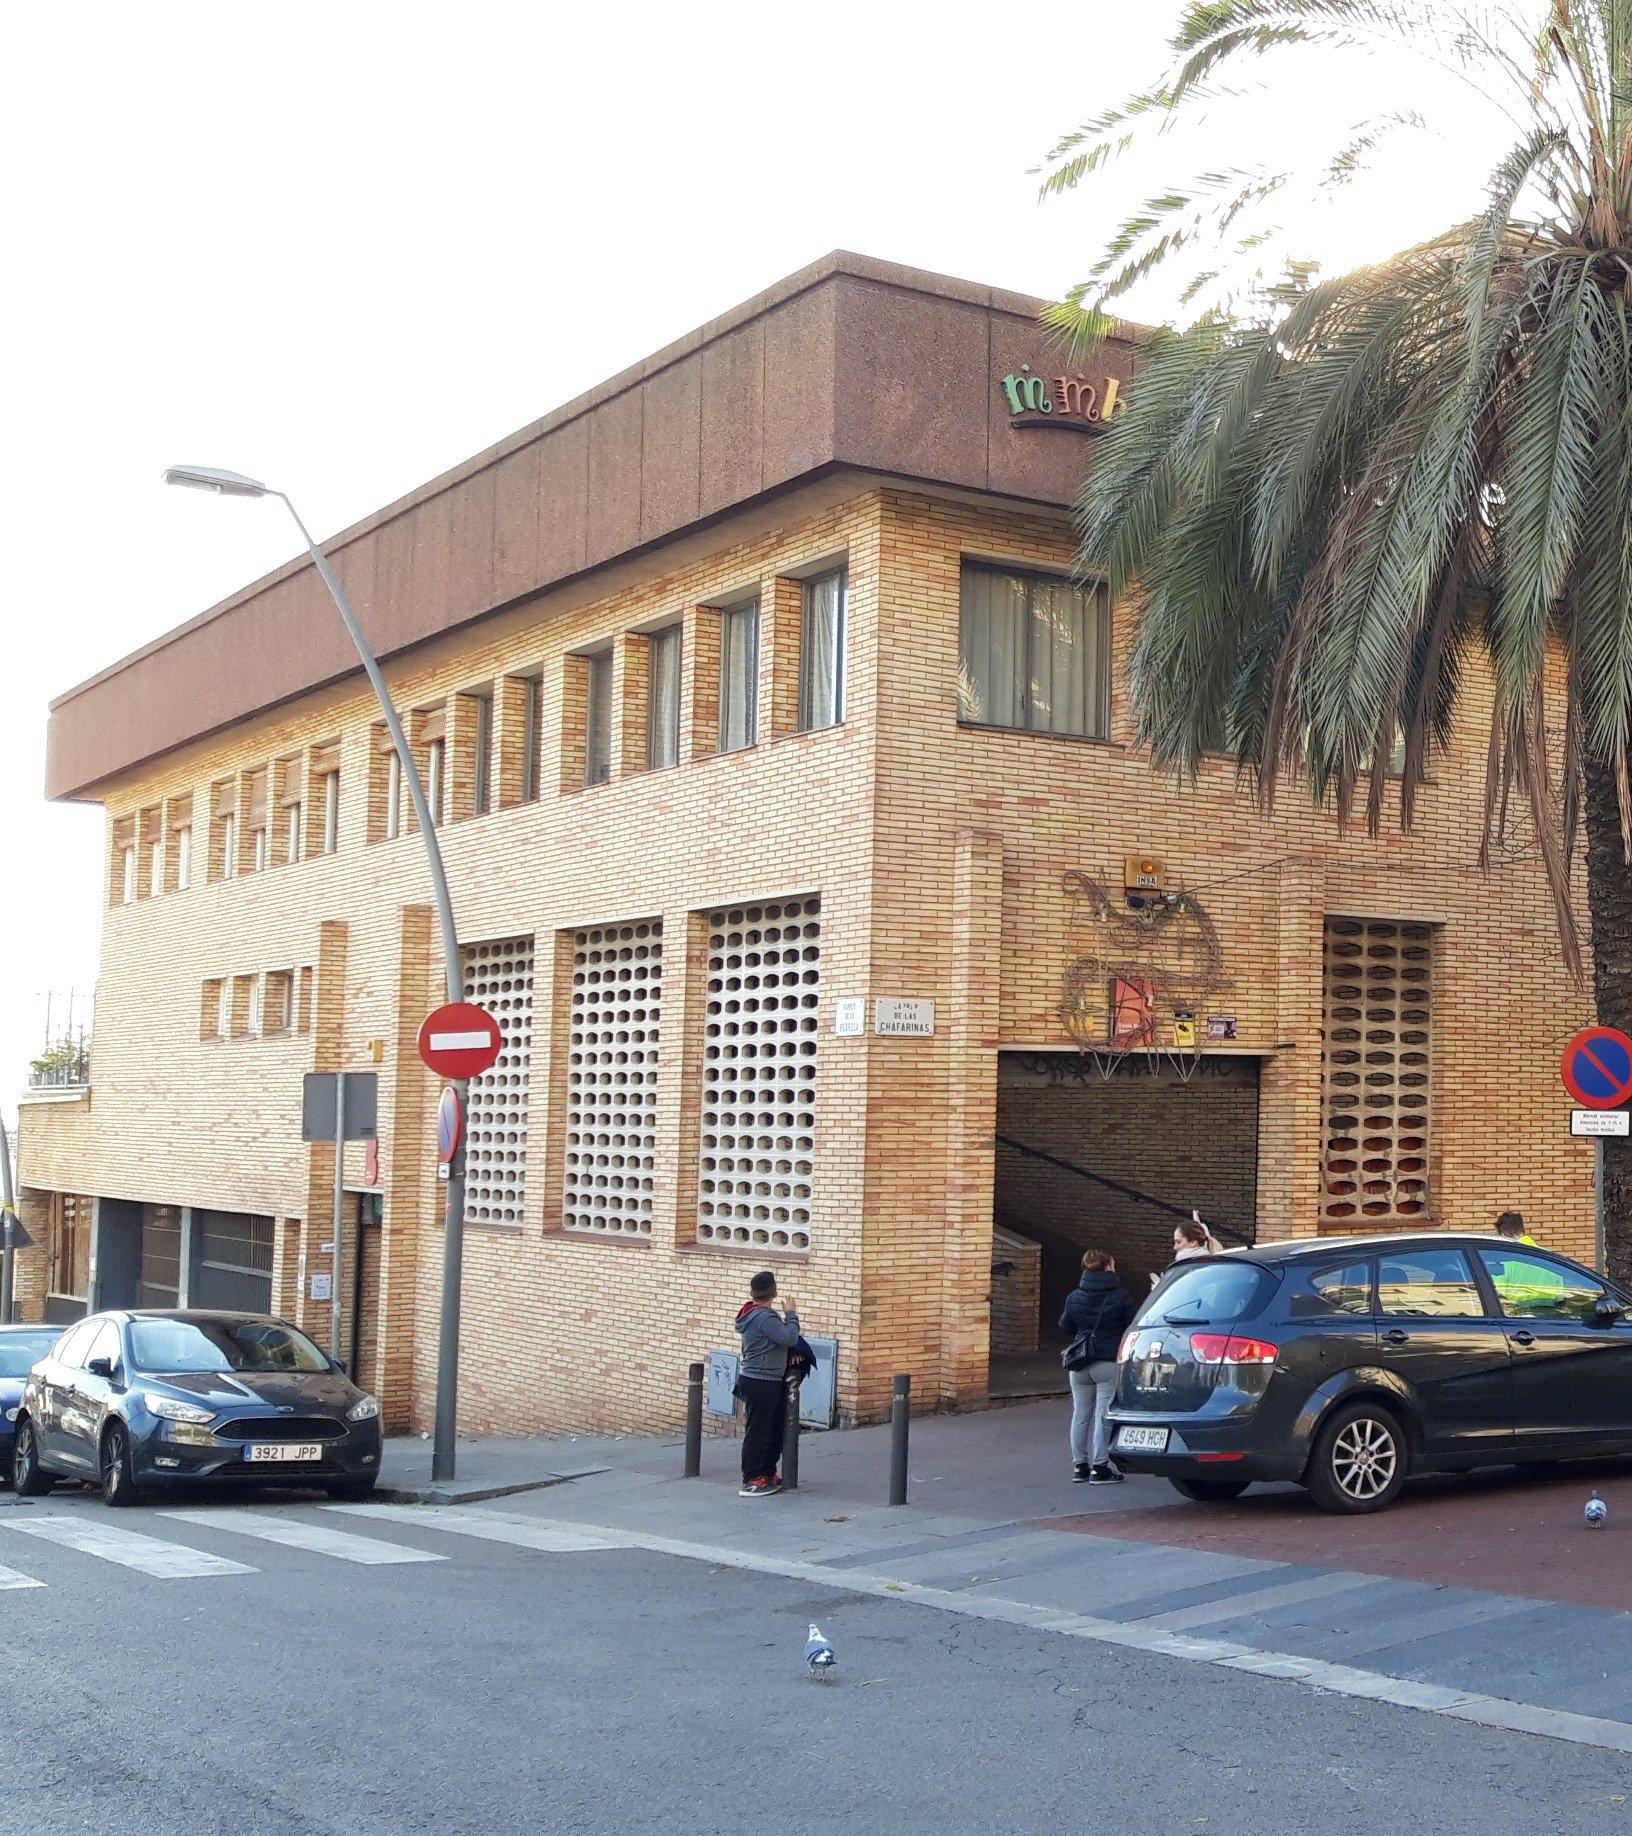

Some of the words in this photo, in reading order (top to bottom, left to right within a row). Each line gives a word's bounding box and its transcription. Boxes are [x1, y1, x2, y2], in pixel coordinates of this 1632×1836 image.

[880, 1021, 930, 1033] CHAFARINAS
[255, 1447, 285, 1459] 3921
[294, 1447, 317, 1459] JPP
